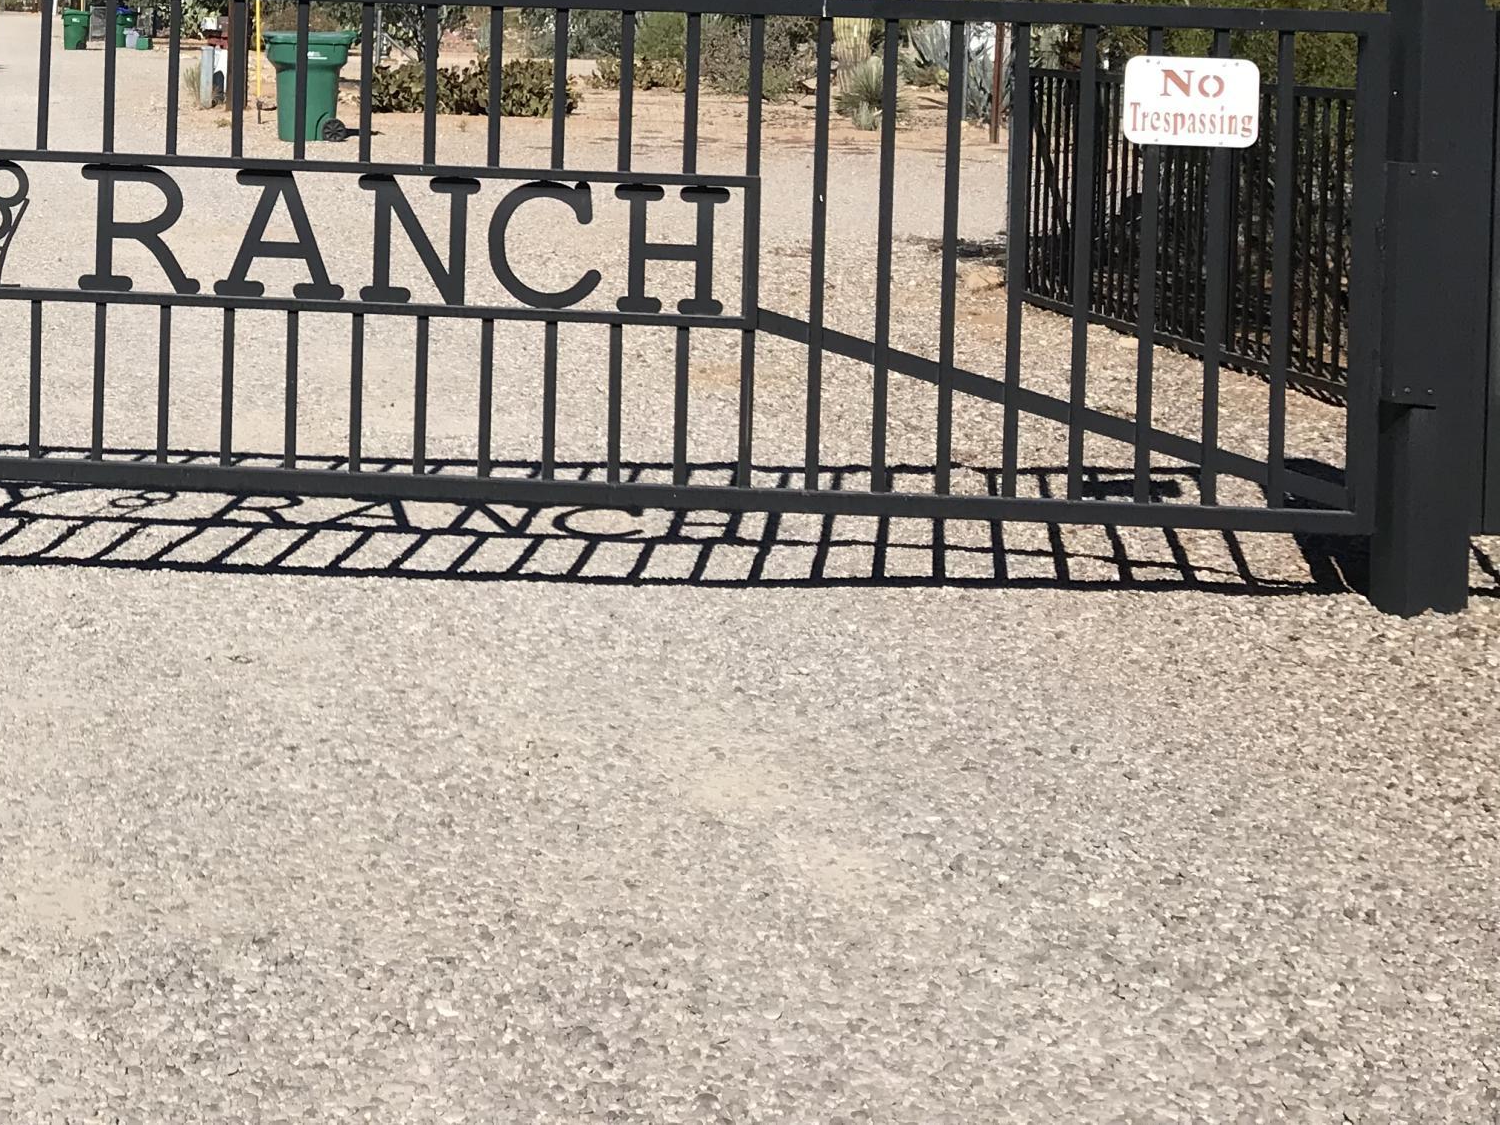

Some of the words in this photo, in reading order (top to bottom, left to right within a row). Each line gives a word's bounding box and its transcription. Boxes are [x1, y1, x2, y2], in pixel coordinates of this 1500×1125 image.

[1160, 69, 1225, 98] No
[1130, 101, 1253, 138] Trespassing
[78, 163, 730, 316] RANCH
